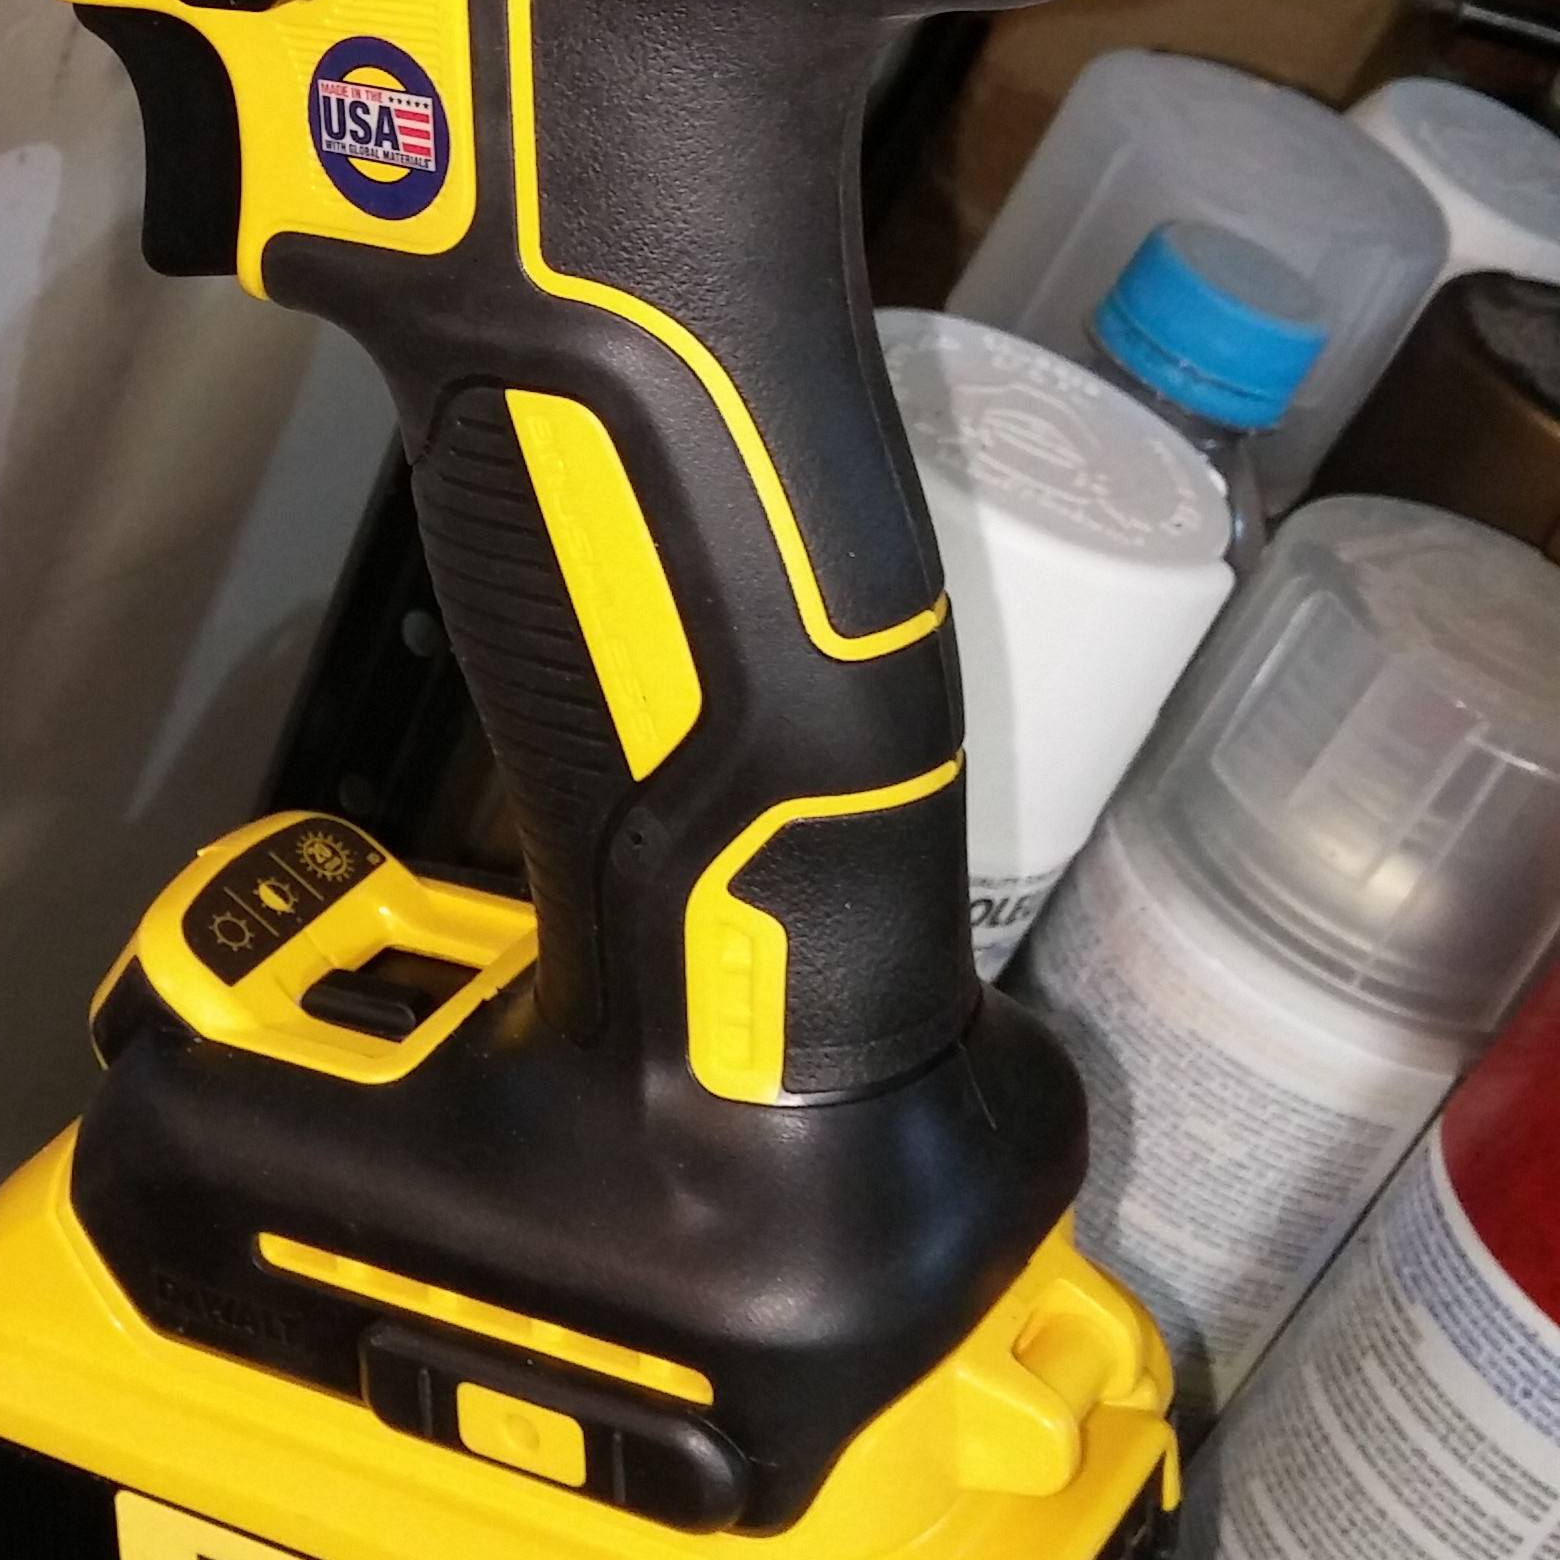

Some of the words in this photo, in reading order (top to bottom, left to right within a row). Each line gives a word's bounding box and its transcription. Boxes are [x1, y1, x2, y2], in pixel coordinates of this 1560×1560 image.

[321, 83, 349, 98] MADE
[351, 87, 361, 99] IN
[365, 89, 384, 104] THE
[322, 95, 401, 151] USA
[325, 140, 347, 151] WITH
[348, 143, 380, 159] GLOBAL
[382, 150, 432, 169] MATERIALS
